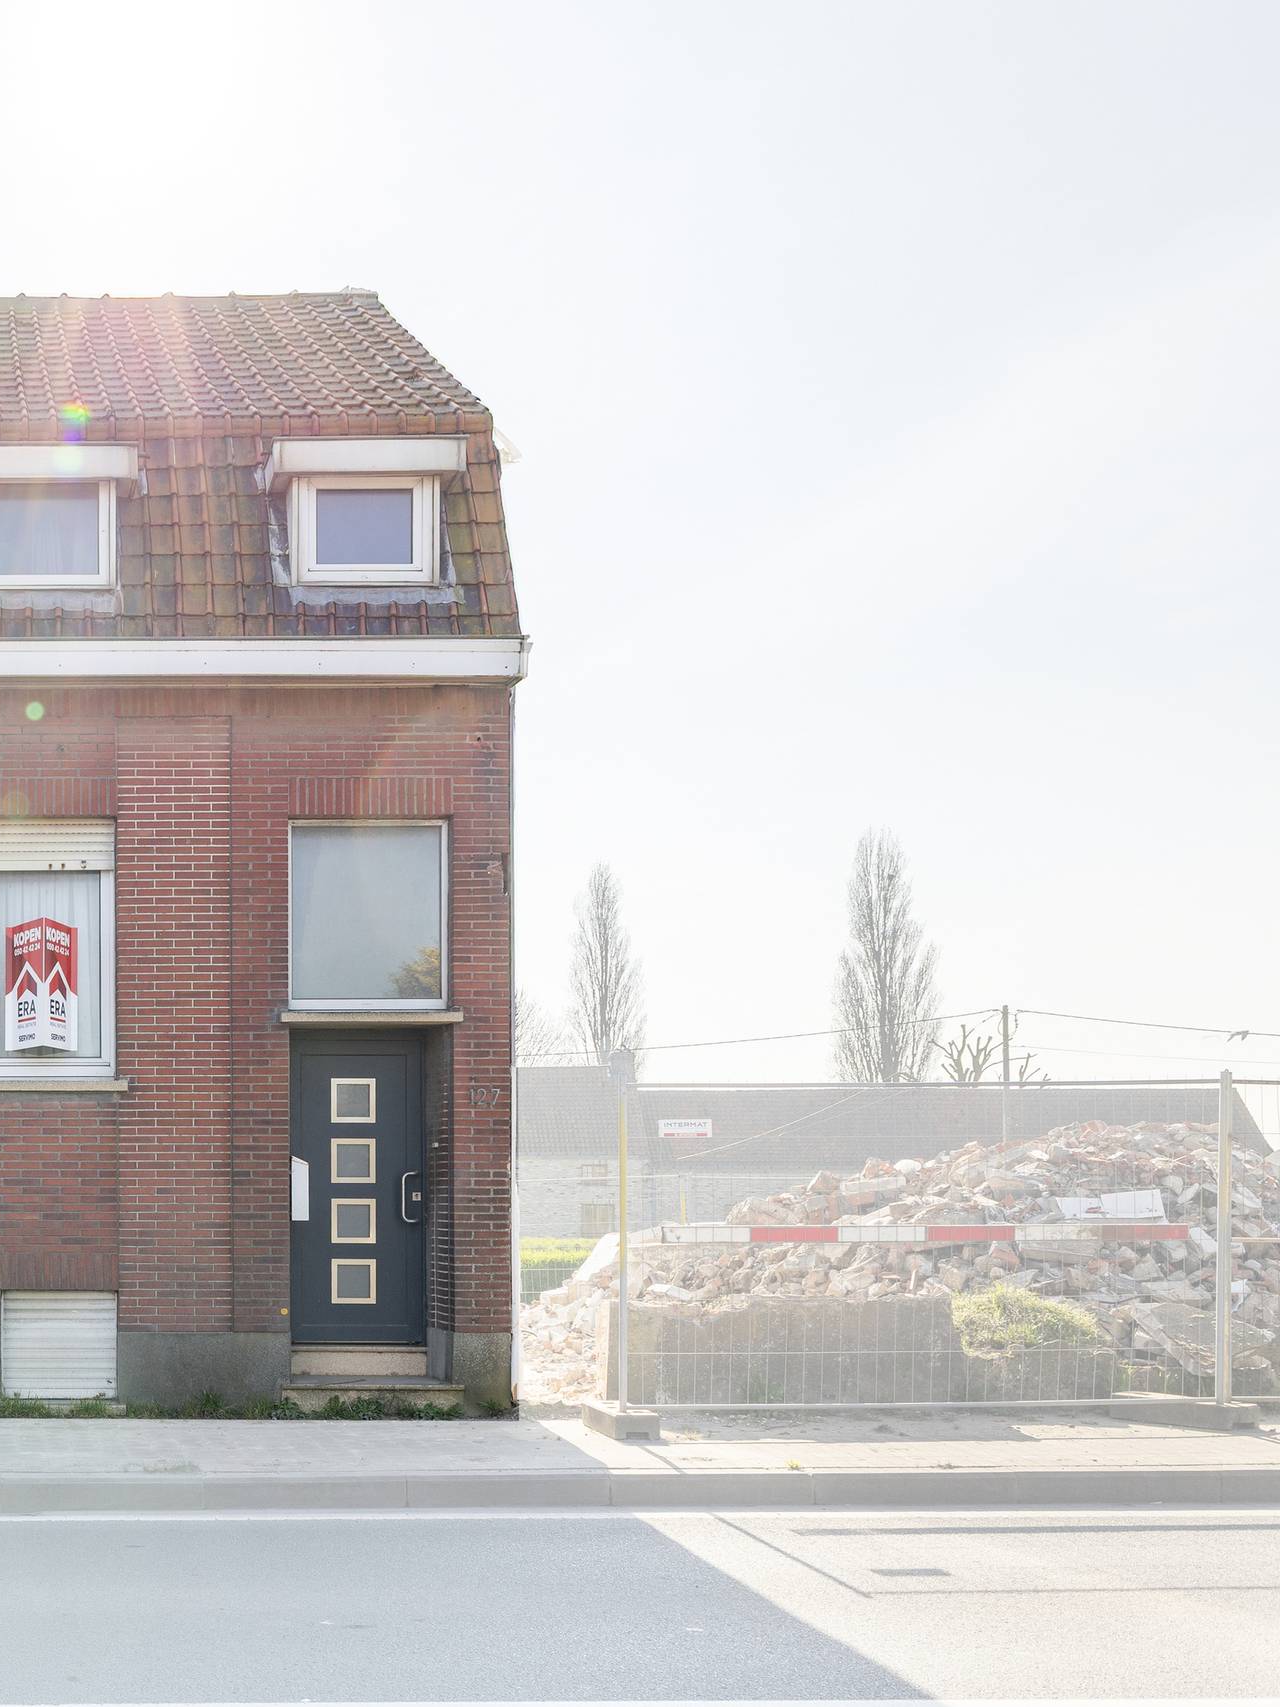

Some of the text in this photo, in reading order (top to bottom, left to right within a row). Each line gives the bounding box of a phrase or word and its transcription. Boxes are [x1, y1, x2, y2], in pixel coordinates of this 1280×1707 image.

[13, 926, 42, 948] KOPEN
[45, 926, 70, 948] KOPEN
[17, 999, 36, 1017] ERA
[49, 999, 66, 1017] ERA
[470, 1088, 500, 1105] 127
